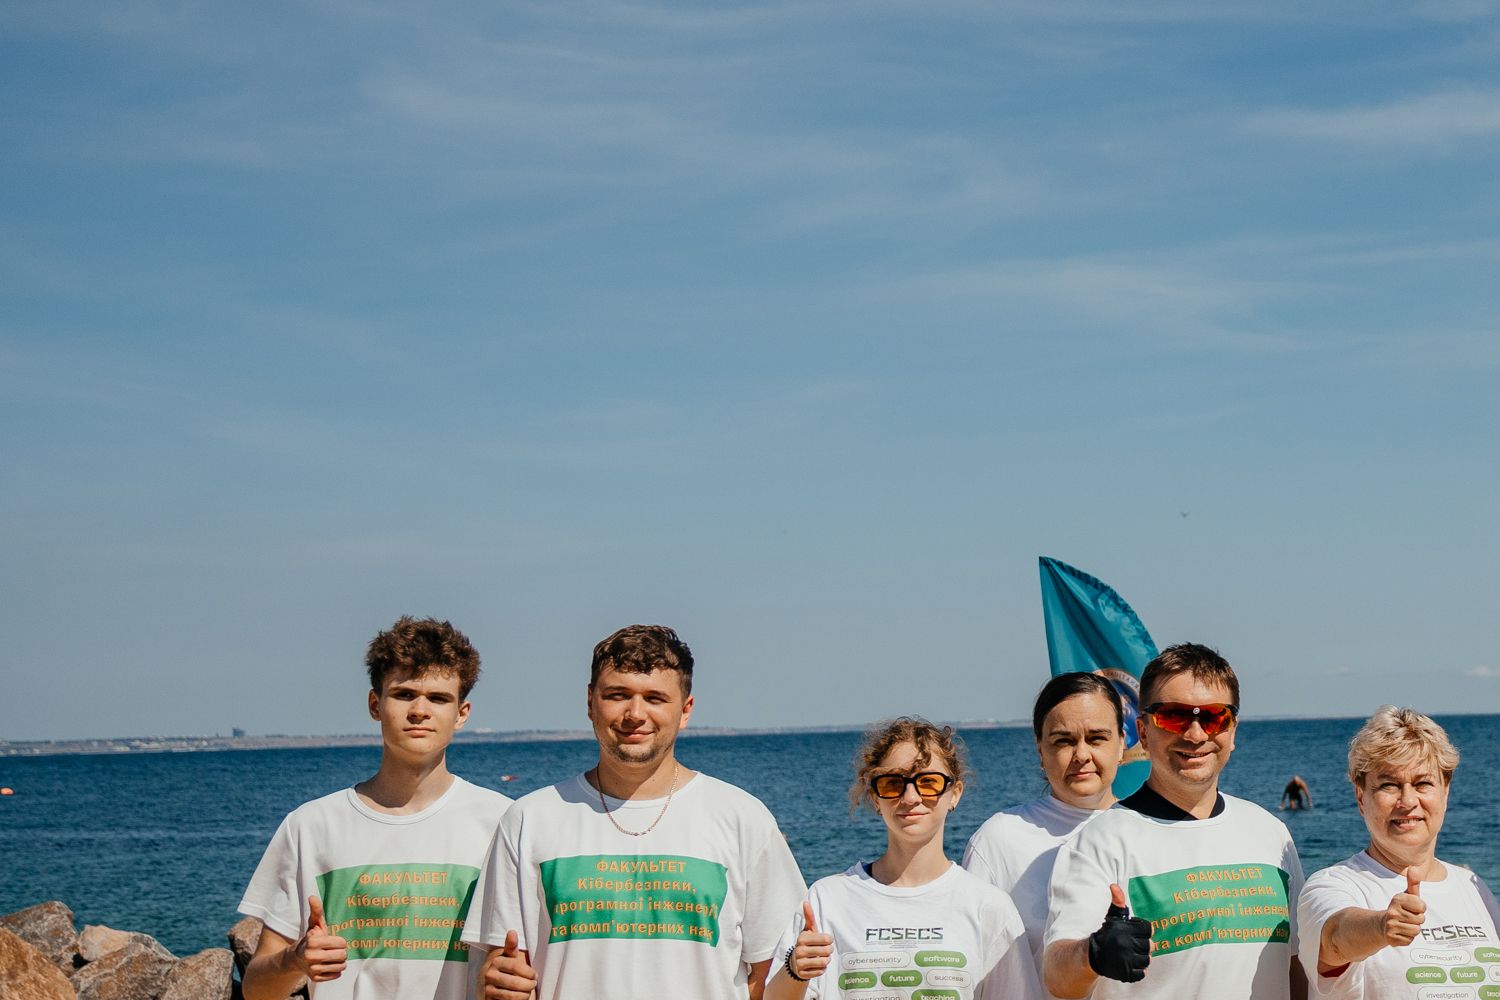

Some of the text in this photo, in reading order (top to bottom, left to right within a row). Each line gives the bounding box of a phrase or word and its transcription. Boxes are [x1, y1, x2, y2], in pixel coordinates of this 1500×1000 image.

[595, 860, 687, 873] ФАКУЛЬТЕТ
[359, 871, 448, 885] ФАКУЛЬТЕТ
[1185, 867, 1263, 883] ФАКУЛЬТЕТ
[577, 877, 697, 893] Кібербезпеки,
[346, 892, 461, 908] Кібербезпеки,
[1173, 886, 1277, 904] Кібербезпеки,
[329, 914, 409, 936] рограмної
[552, 925, 567, 937] та
[570, 919, 684, 935] комп'ютерних
[865, 927, 944, 941] FCSECS
[1420, 925, 1488, 941] FCSECS
[1152, 940, 1171, 951] та
[848, 955, 902, 966] cybersecurity
[888, 974, 915, 983] future
[1414, 970, 1441, 978] science
[1426, 991, 1469, 1000] investigation
